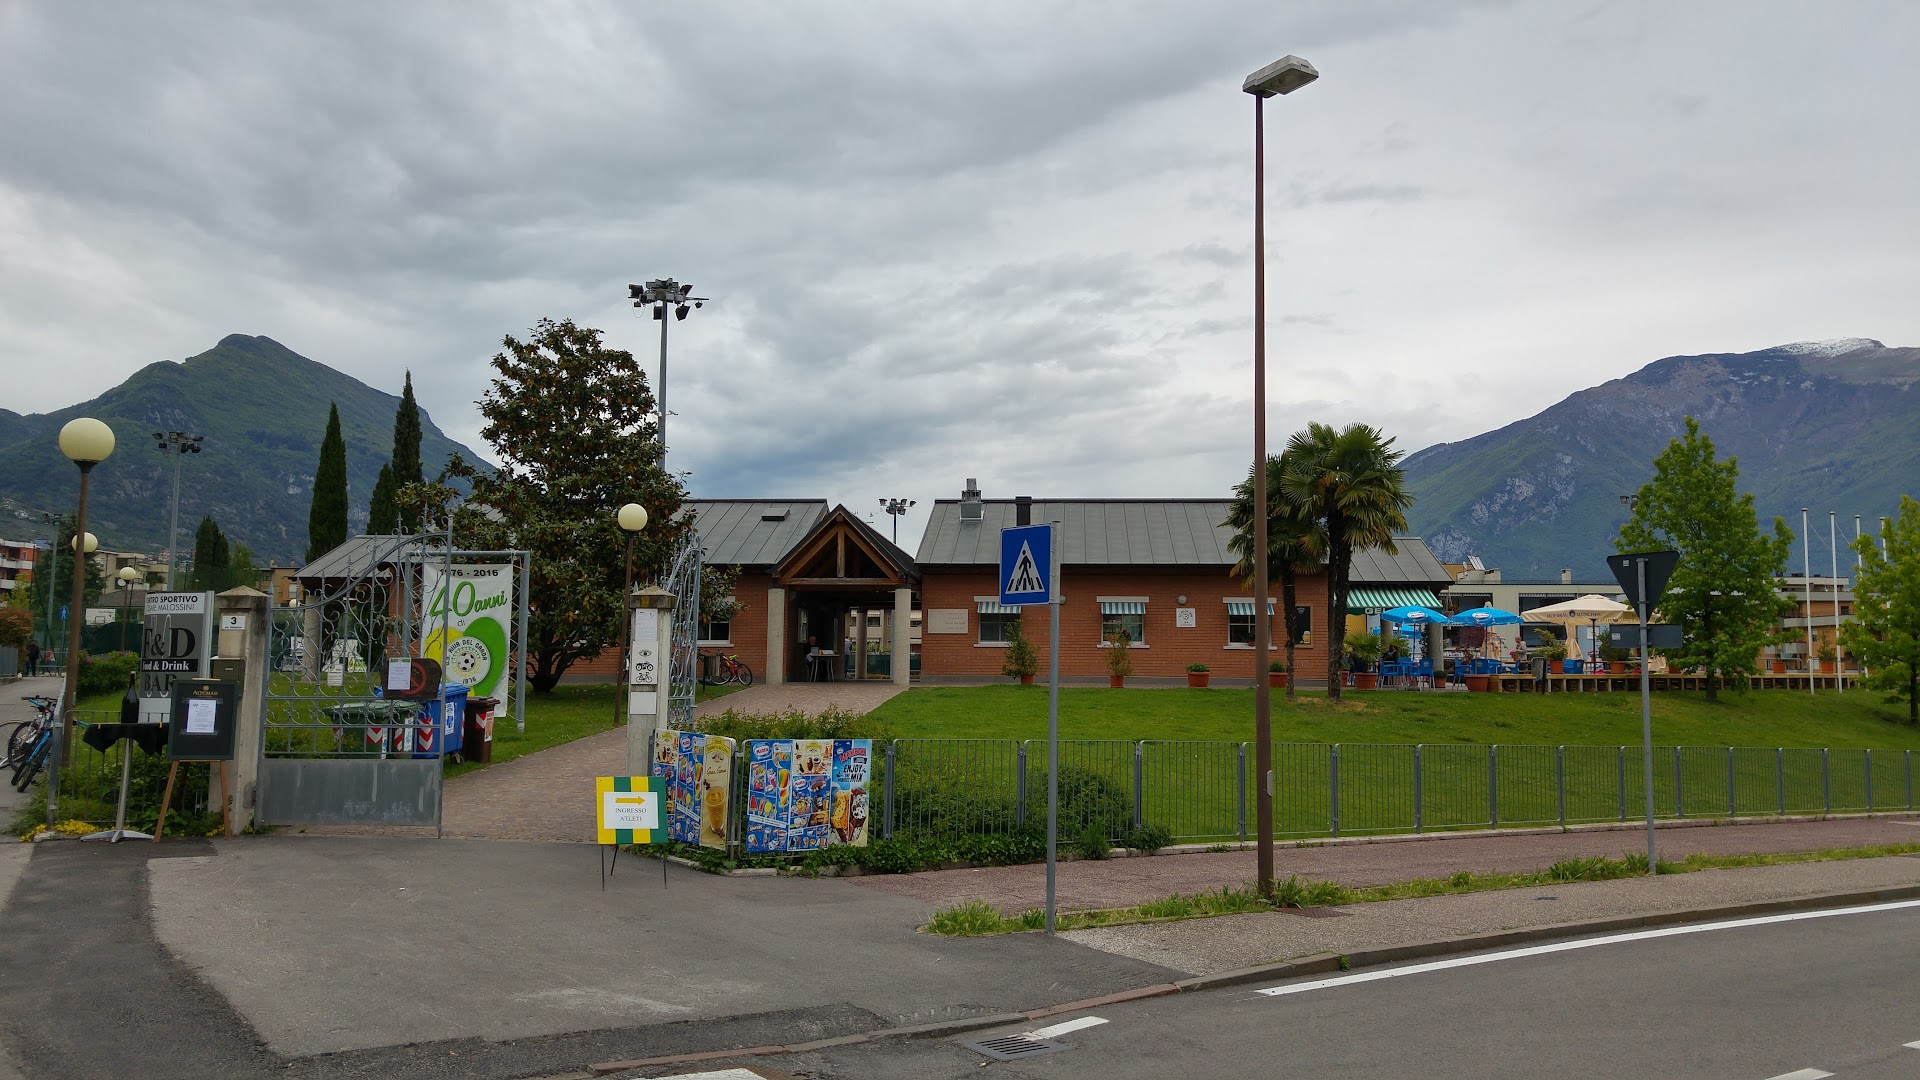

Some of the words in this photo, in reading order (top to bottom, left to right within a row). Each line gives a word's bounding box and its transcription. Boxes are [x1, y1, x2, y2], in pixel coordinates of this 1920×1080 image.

[440, 569, 463, 577] 176
[473, 569, 499, 577] 2016
[160, 595, 198, 603] SPORTIVO
[158, 603, 195, 612] MALOSSINI
[230, 616, 237, 625] 3
[457, 619, 466, 627] di
[474, 642, 488, 661] GARDA
[153, 660, 160, 670] &
[162, 660, 190, 671] Drink
[144, 673, 177, 691] BAR
[462, 676, 477, 685] 1976
[843, 764, 863, 773] ENJOY
[850, 772, 864, 781] MIX
